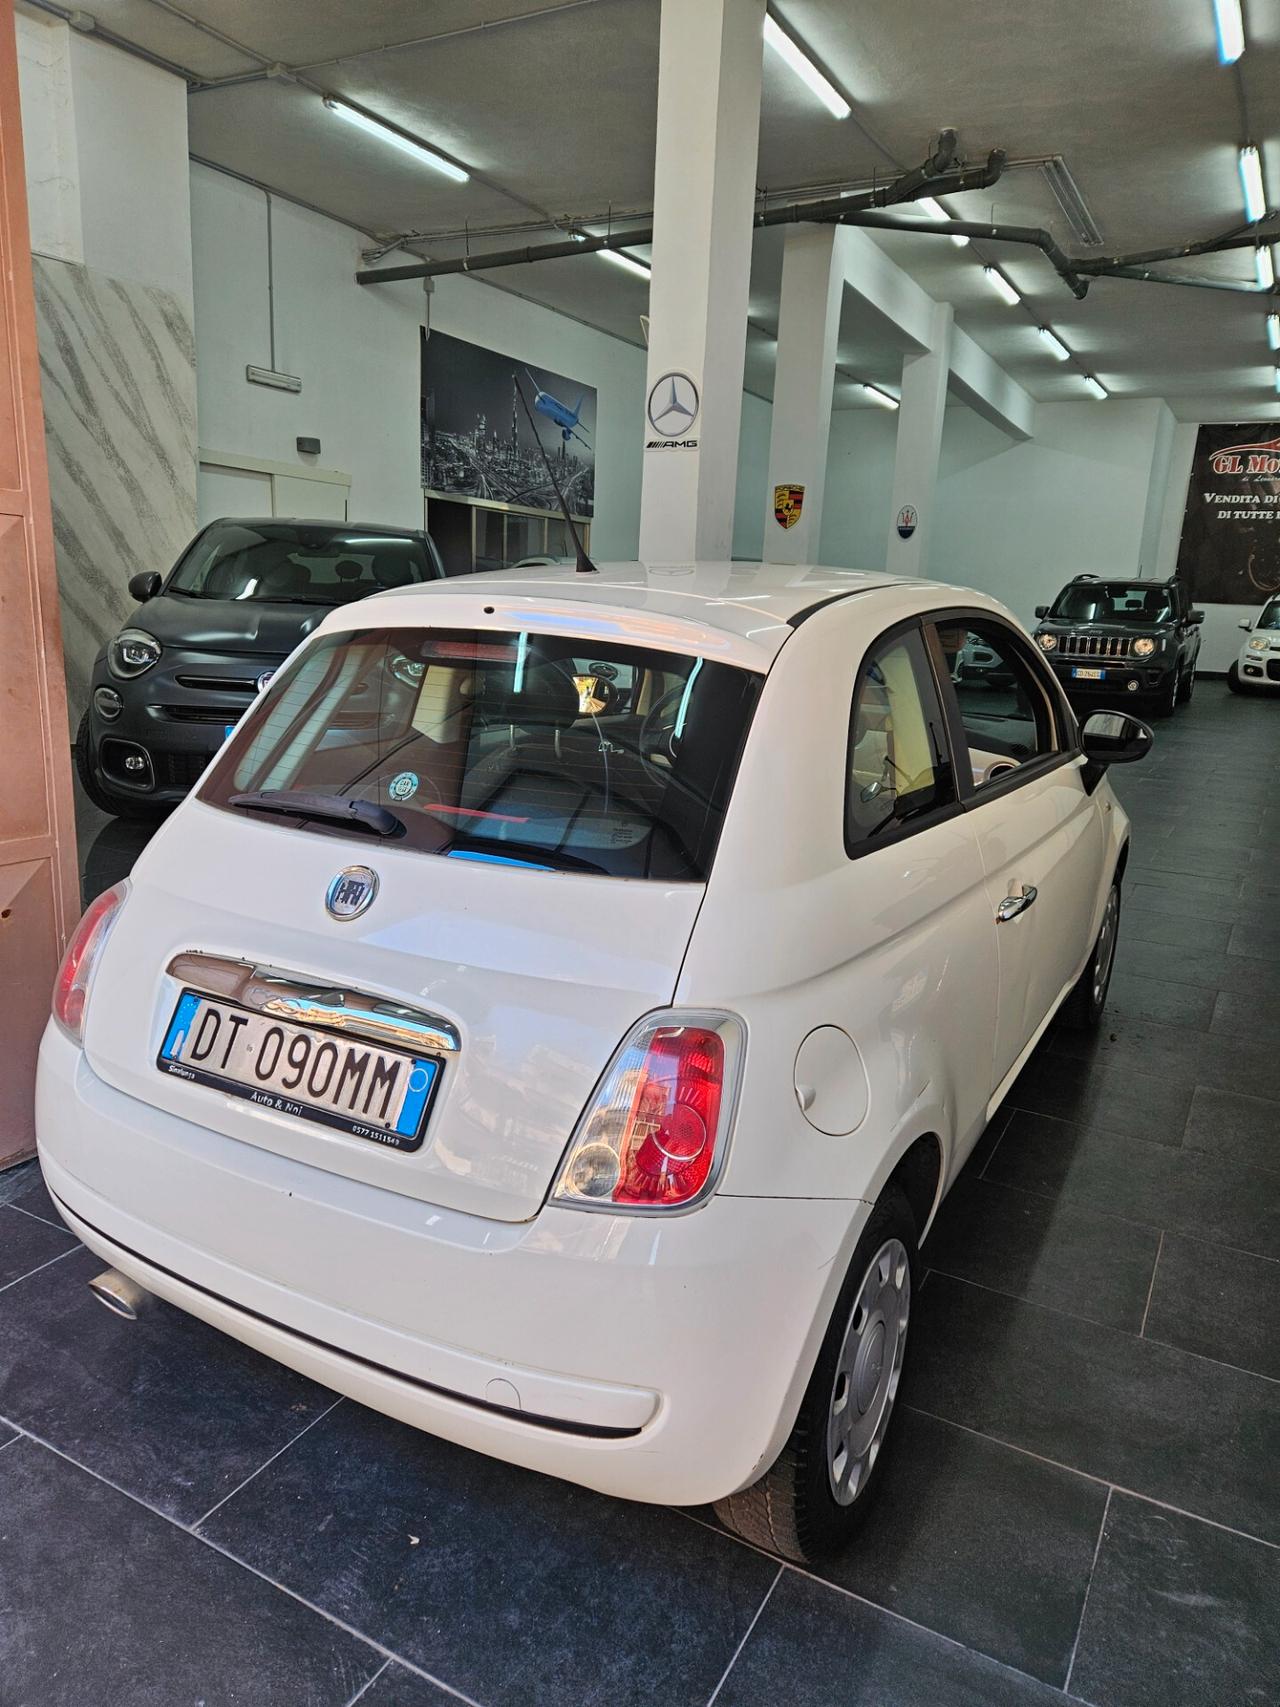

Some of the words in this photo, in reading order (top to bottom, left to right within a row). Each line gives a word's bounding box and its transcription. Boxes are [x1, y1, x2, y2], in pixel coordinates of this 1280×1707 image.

[662, 440, 698, 448] AMG
[1213, 455, 1243, 474] GL
[1246, 454, 1280, 474] MO
[1204, 493, 1260, 504] VENDITA
[1217, 510, 1232, 519] DI
[1233, 510, 1274, 519] TUTTE
[190, 1008, 249, 1070] DT
[255, 1027, 402, 1119] 090MM
[250, 1091, 273, 1106] Auto
[274, 1099, 283, 1110] &
[352, 1125, 370, 1136] 0577
